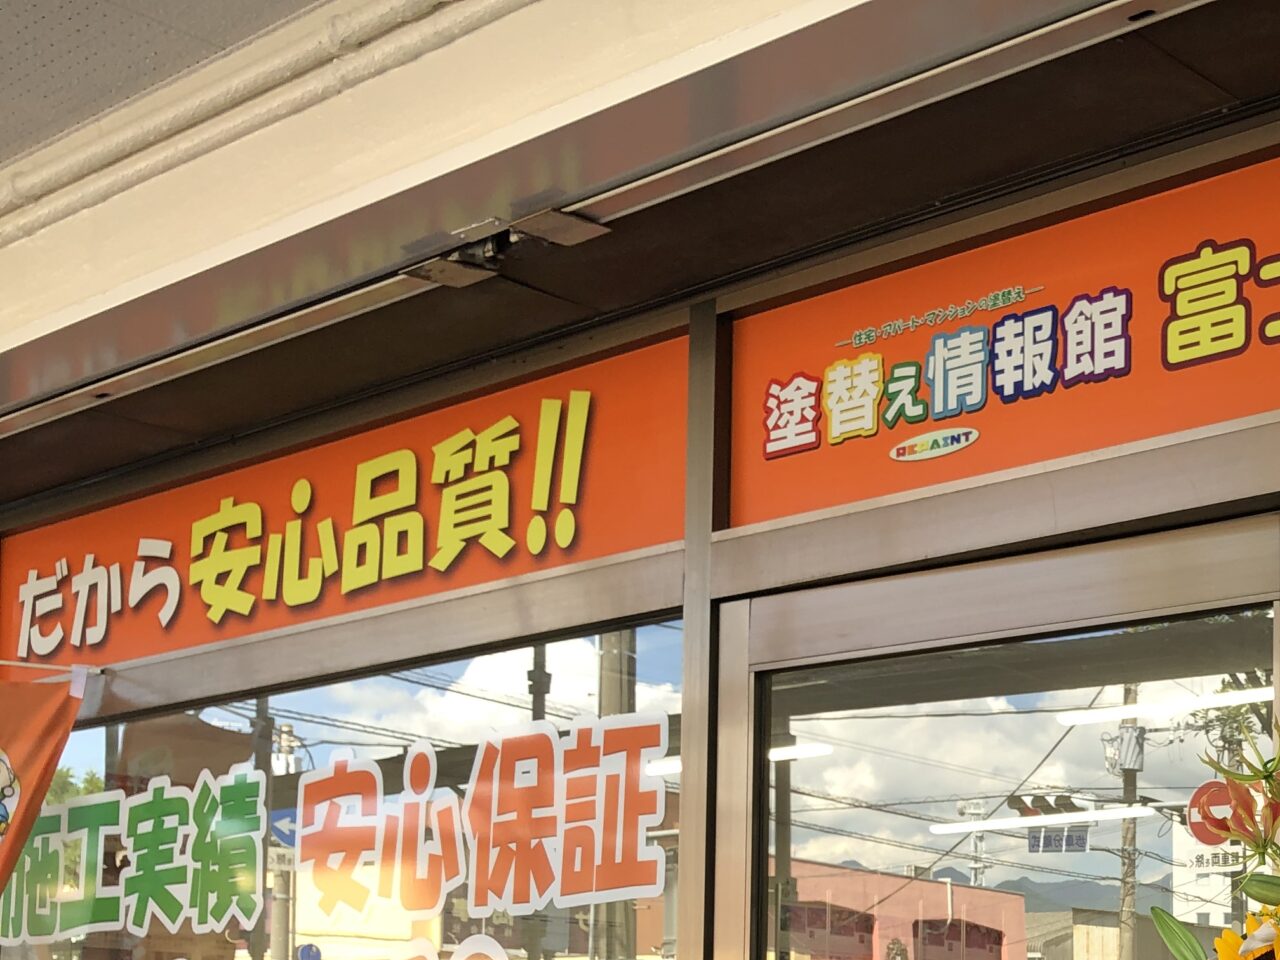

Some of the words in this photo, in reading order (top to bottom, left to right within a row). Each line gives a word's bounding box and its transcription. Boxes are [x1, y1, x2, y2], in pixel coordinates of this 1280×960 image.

[765, 291, 1132, 456] 塗替え情報館
[895, 430, 973, 459] REPAINT
[298, 722, 663, 917] 安心保証
